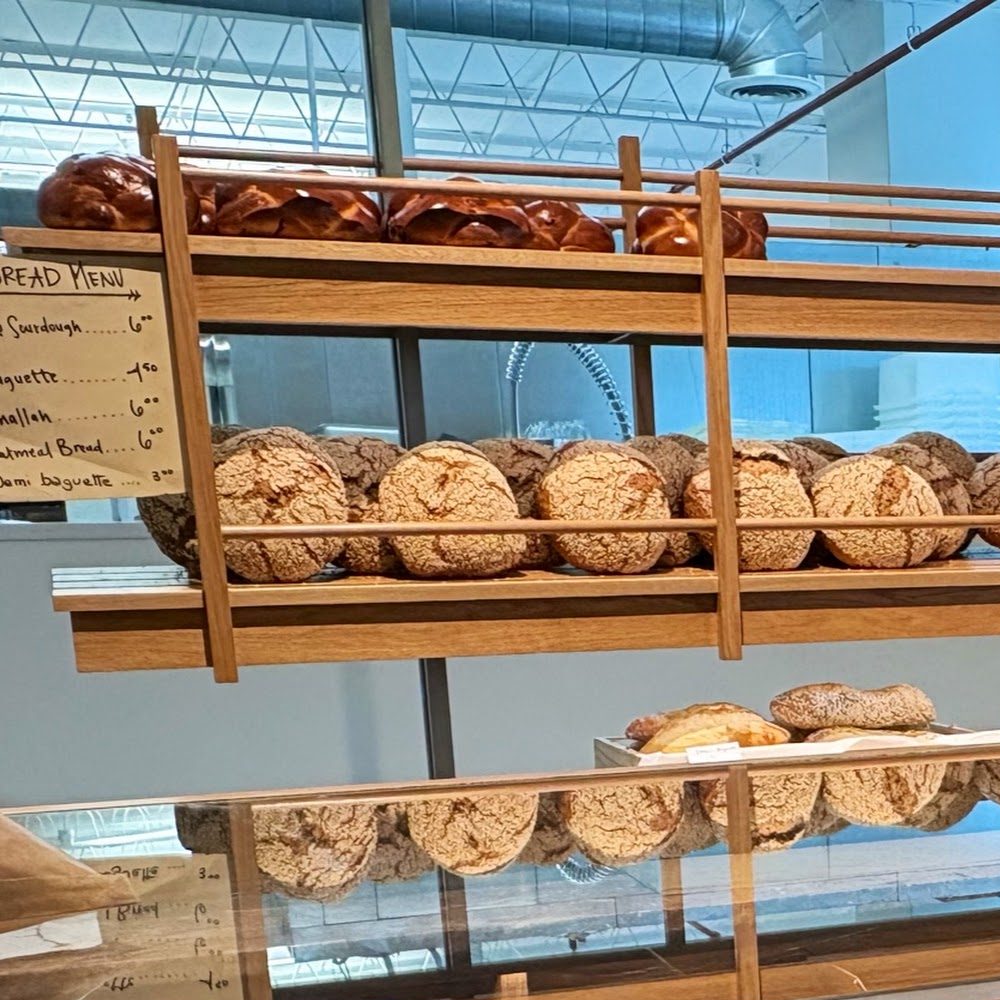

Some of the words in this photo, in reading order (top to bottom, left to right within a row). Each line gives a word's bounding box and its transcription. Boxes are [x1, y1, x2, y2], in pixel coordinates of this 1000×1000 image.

[68, 260, 124, 290] MENU
[7, 315, 82, 338] Sourdough
[56, 438, 103, 457] Bread
